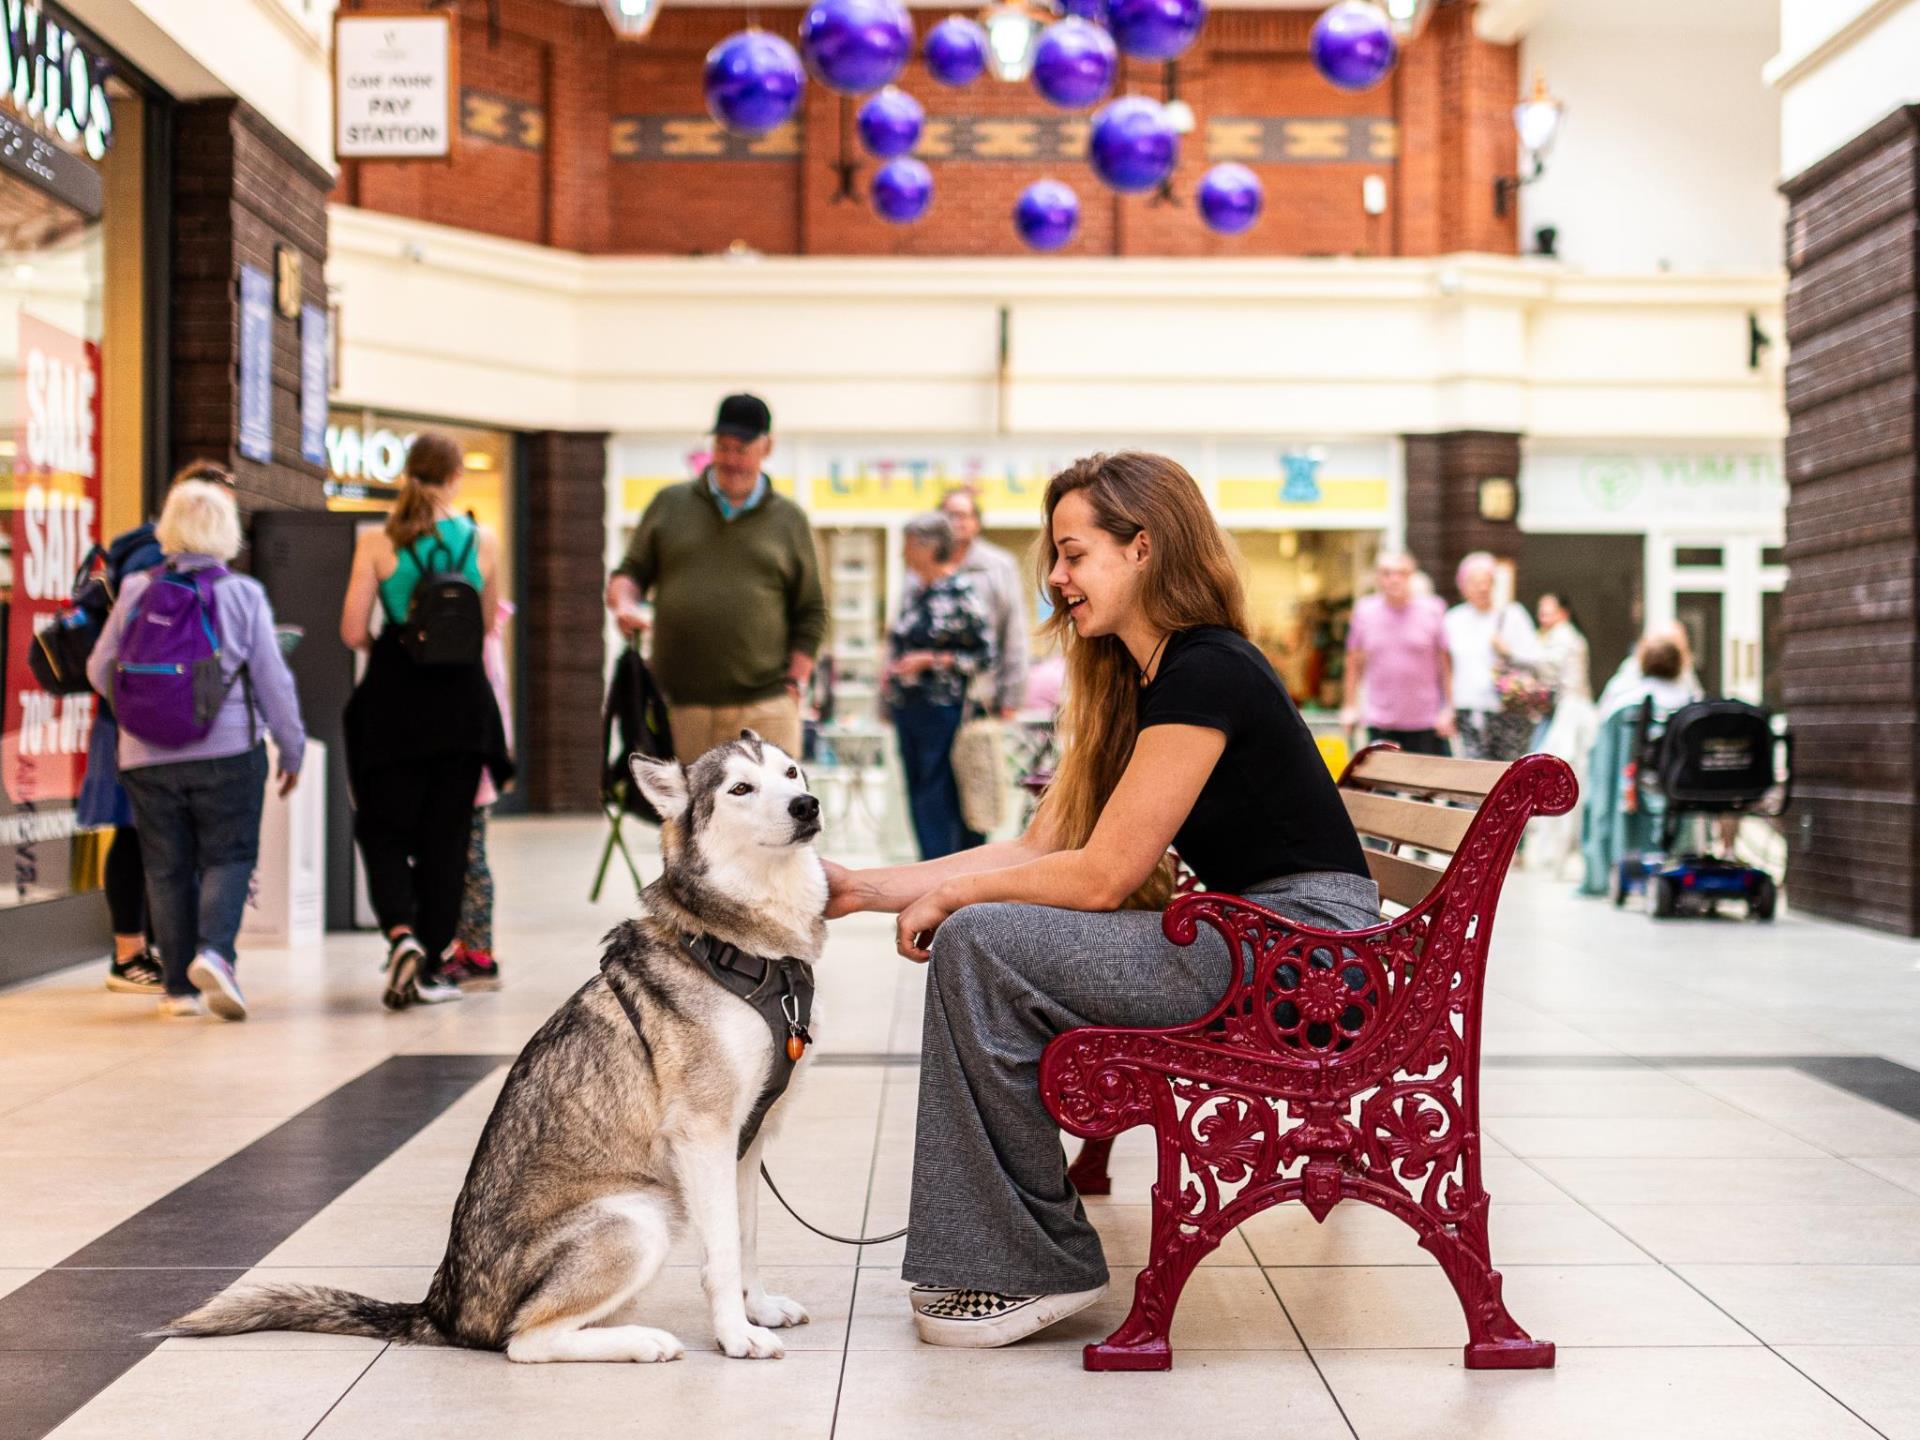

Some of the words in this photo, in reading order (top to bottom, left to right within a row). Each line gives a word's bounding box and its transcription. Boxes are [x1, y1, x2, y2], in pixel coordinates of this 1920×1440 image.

[368, 97, 411, 115] PAY
[346, 125, 437, 144] STATION
[26, 349, 96, 479] SALE
[59, 692, 94, 754] OFF
